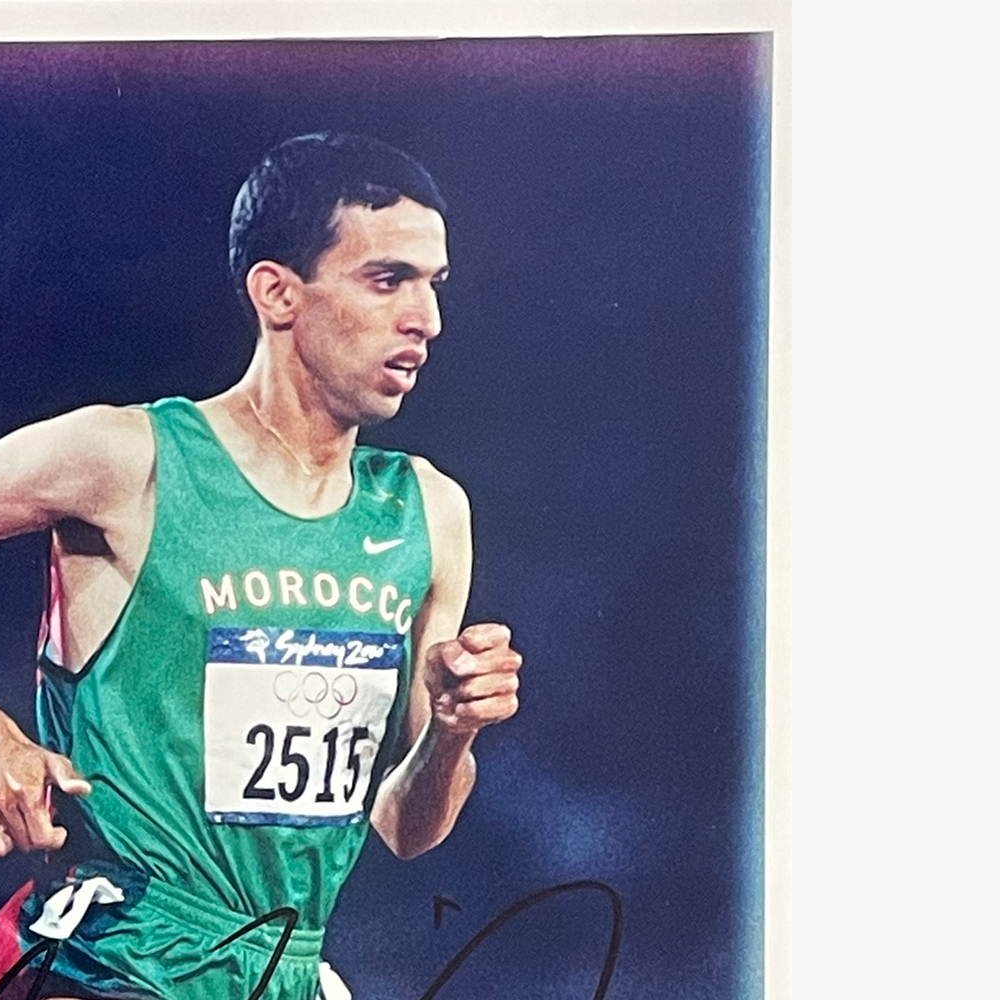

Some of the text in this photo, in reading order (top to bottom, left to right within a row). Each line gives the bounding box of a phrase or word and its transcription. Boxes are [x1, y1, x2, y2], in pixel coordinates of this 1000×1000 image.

[200, 569, 412, 634] MOROCCO
[275, 629, 346, 668] Sydney
[242, 723, 370, 803] 2515
